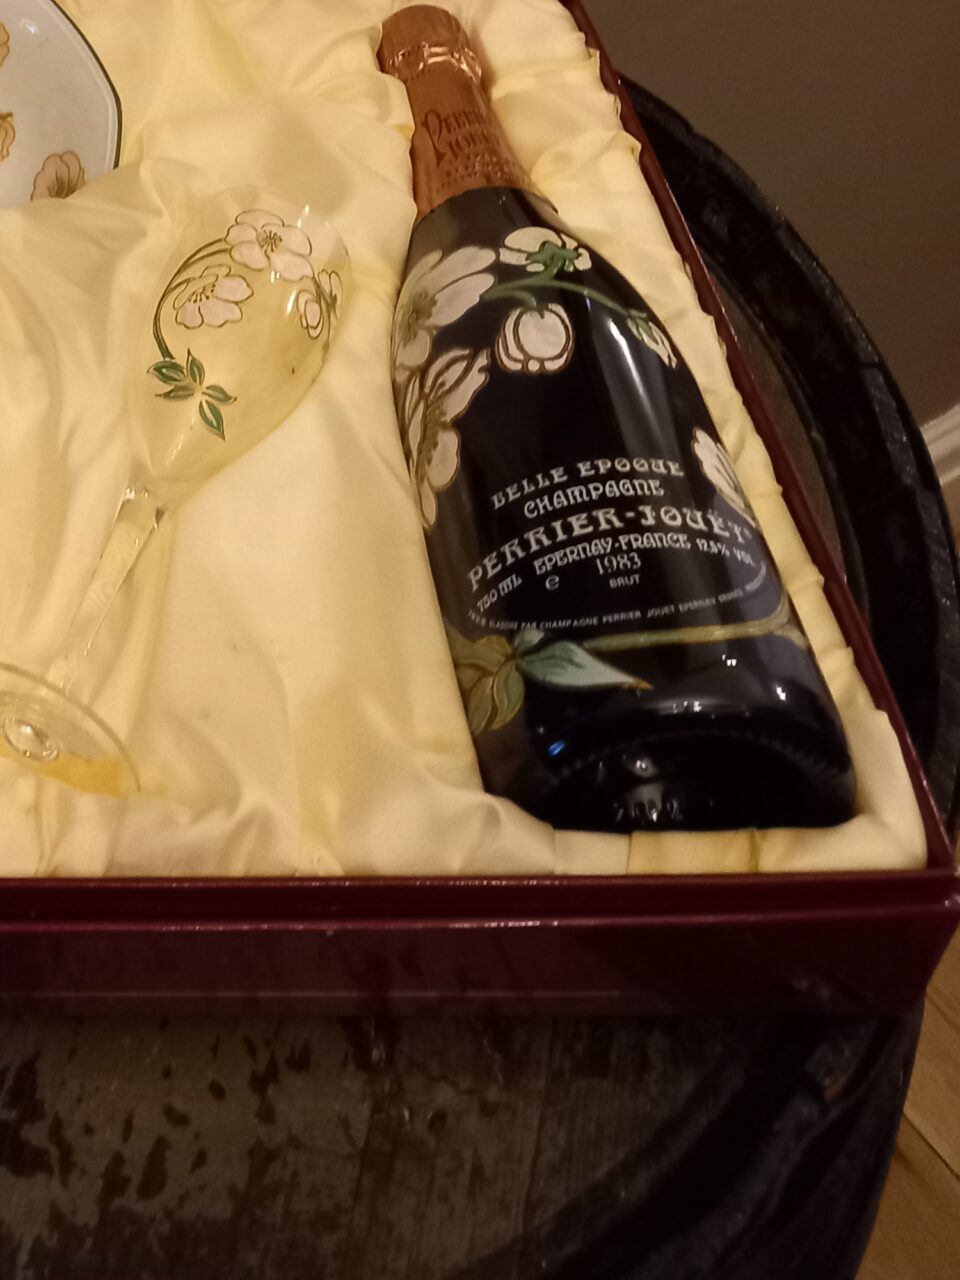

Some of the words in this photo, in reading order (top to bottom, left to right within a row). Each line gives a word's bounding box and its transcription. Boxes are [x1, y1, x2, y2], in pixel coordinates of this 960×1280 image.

[490, 466, 568, 510] BELLE
[524, 478, 665, 519] CHAMPAGNE
[596, 551, 641, 576] 1983
[609, 574, 640, 590] BRUT
[540, 615, 598, 630] CHAMPAGNE
